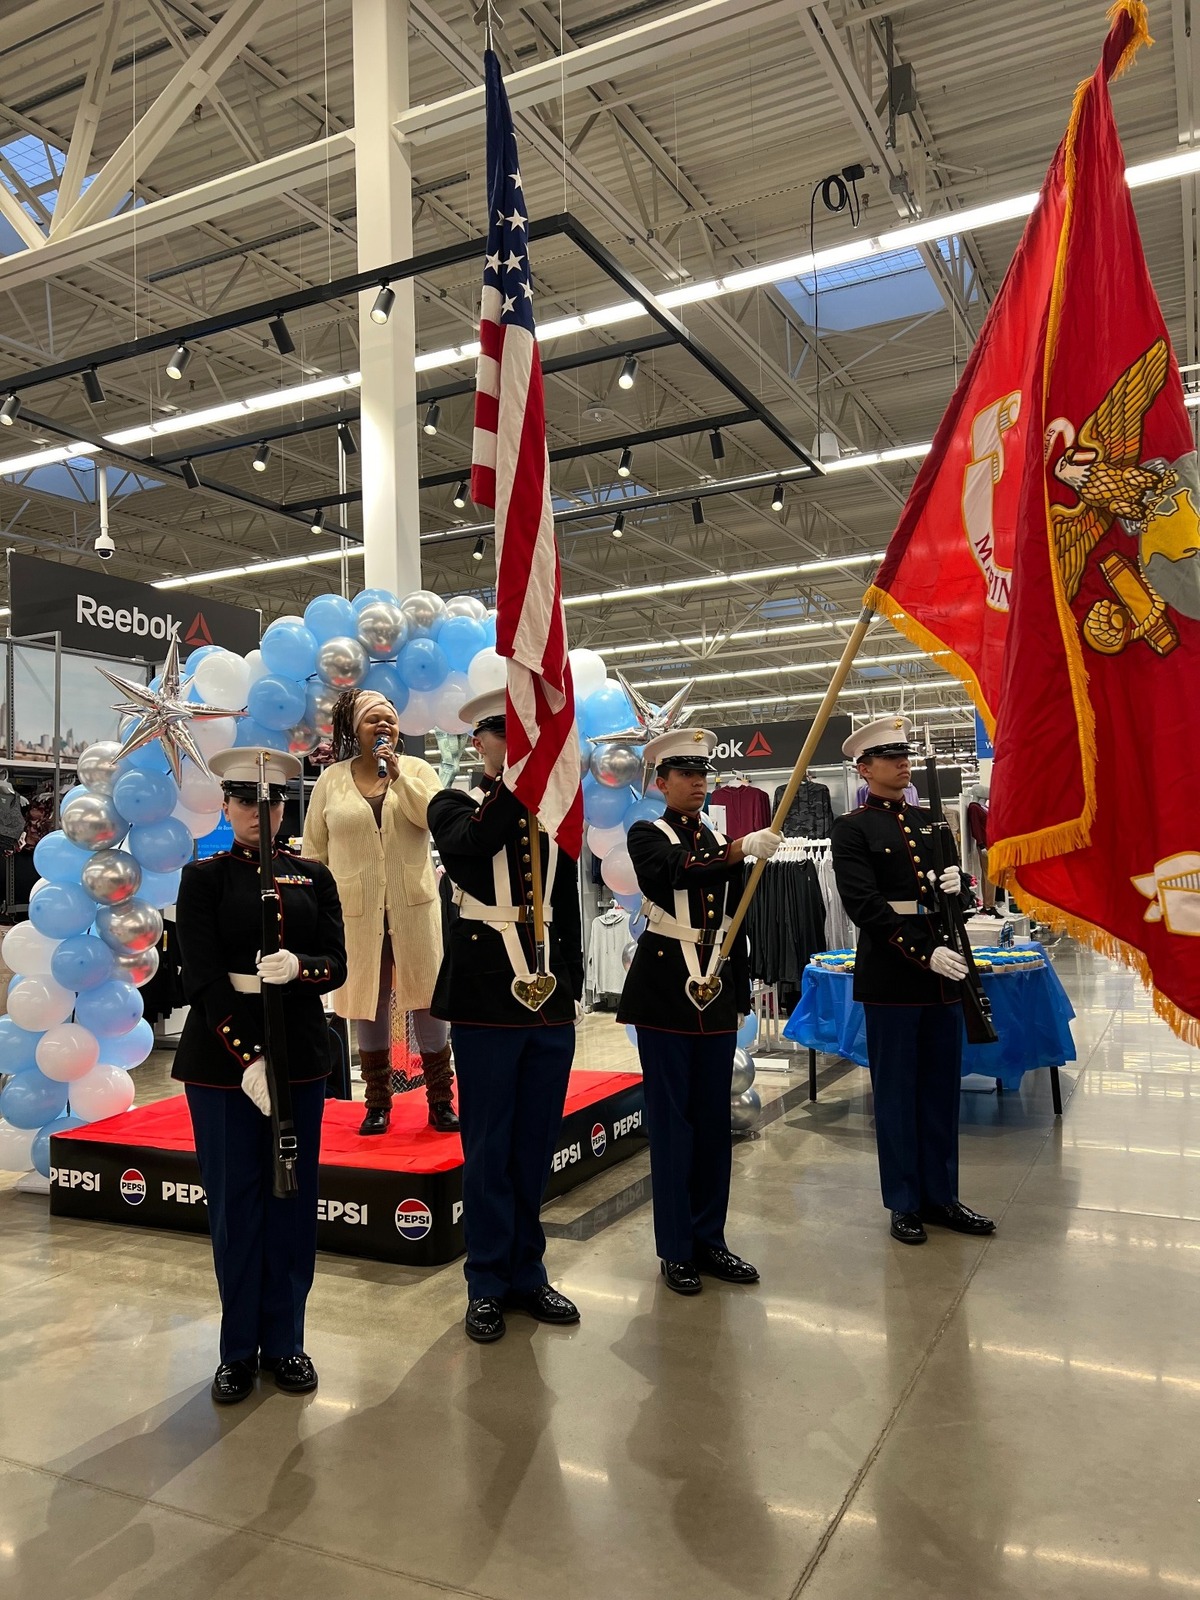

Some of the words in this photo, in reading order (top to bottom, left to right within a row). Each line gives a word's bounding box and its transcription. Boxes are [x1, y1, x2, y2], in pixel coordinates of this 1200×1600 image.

[76, 594, 182, 643] Reebok
[613, 1109, 642, 1140] PEPSI
[592, 1134, 606, 1146] PEPSI
[550, 1141, 581, 1173] EPSI
[121, 1181, 145, 1193] PEPSI
[397, 1213, 430, 1225] PEPSI
